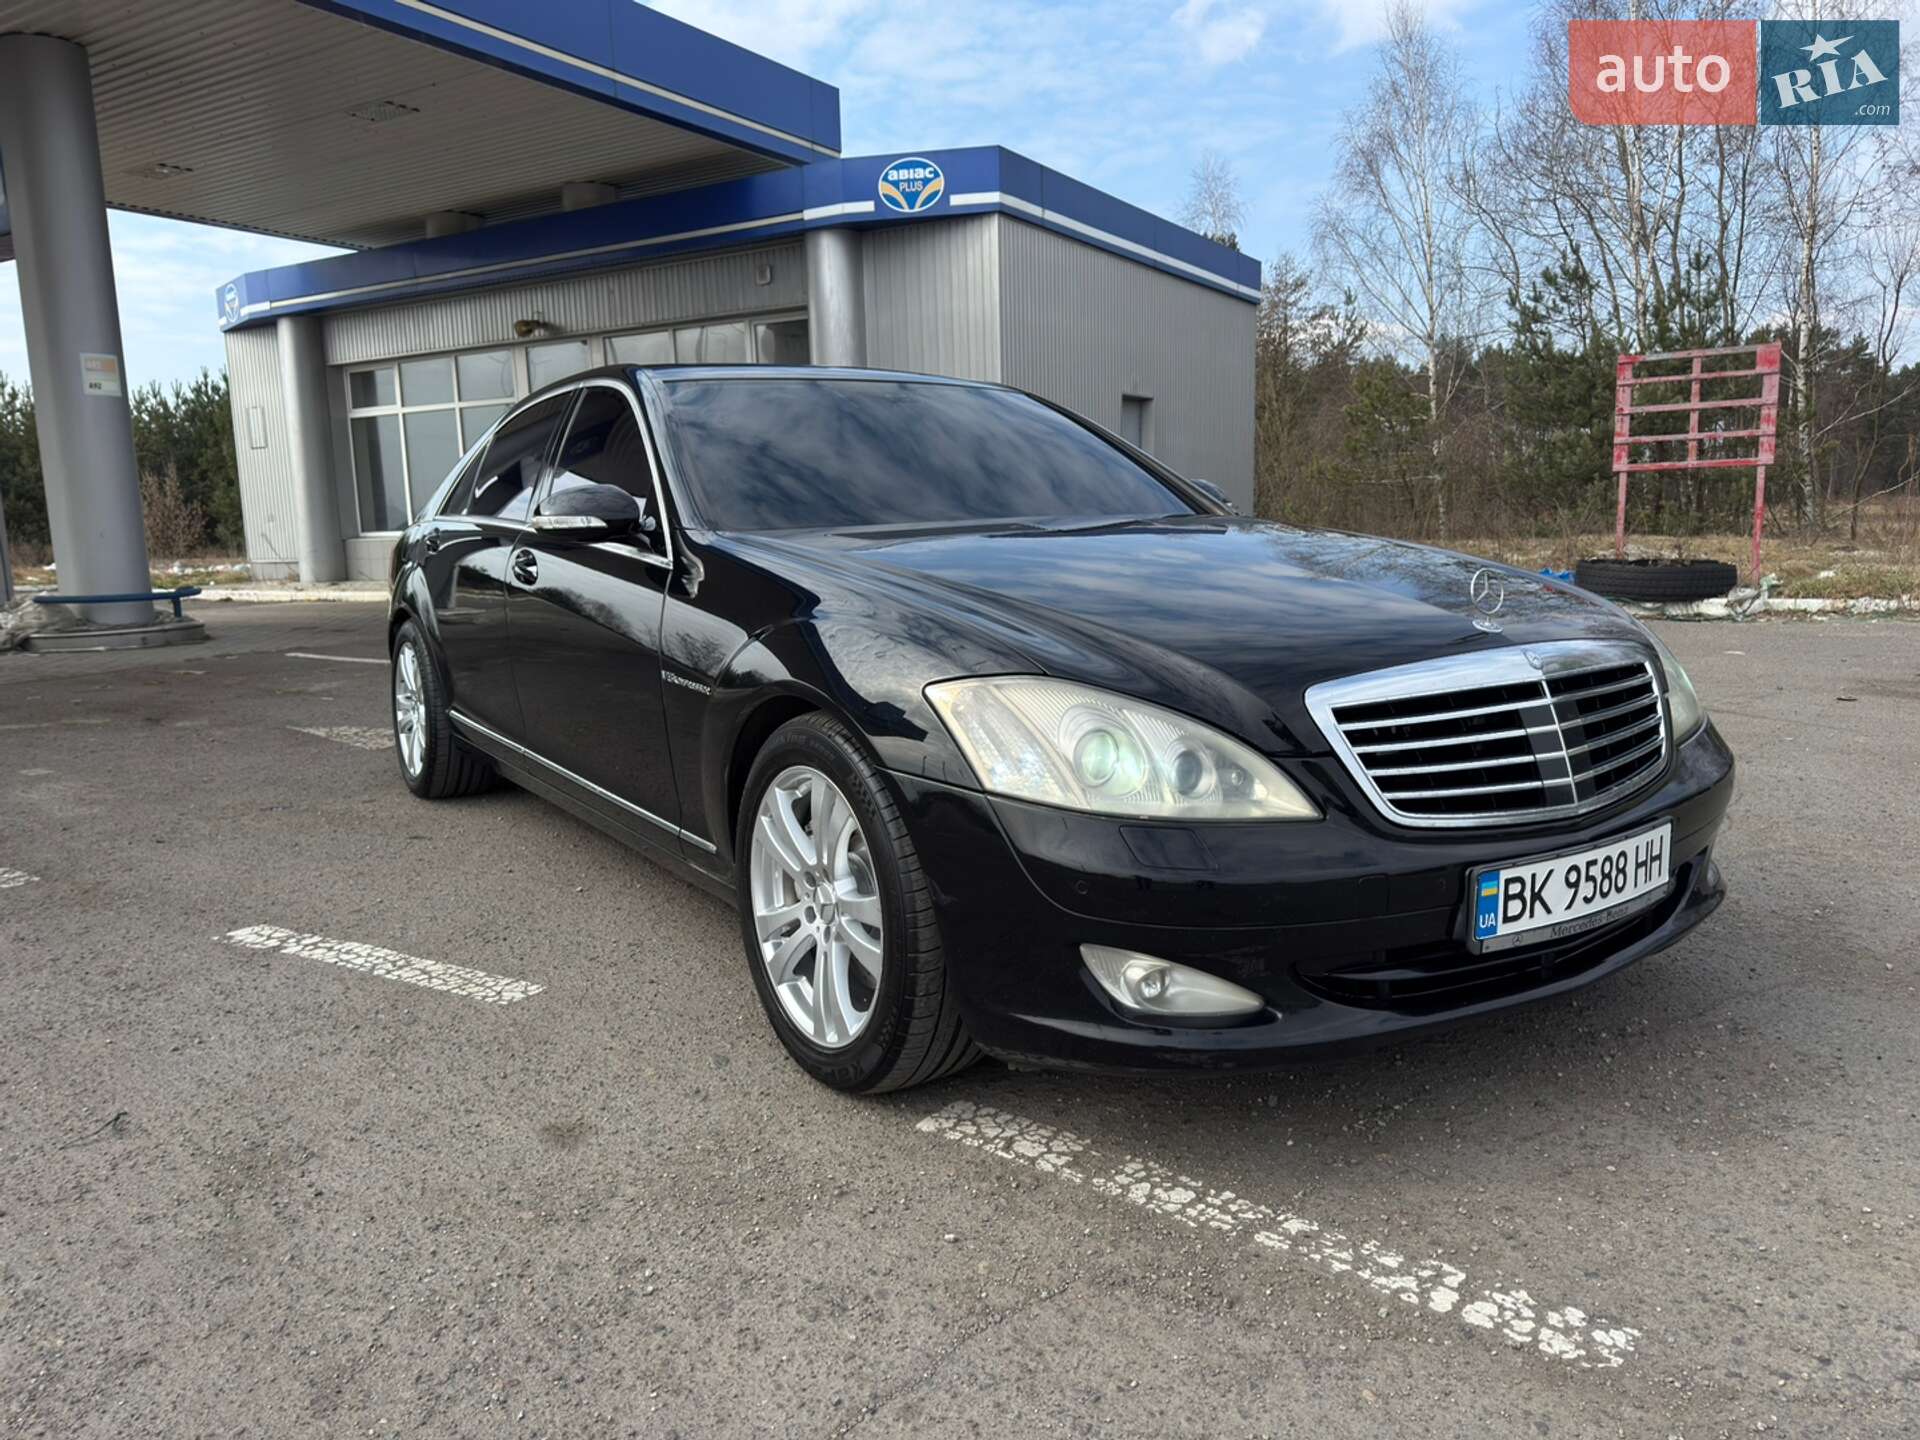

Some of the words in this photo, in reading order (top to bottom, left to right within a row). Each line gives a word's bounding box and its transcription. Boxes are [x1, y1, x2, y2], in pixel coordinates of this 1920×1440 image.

[899, 180, 924, 192] PLUS
[1502, 868, 1554, 925] BK
[1563, 850, 1628, 912] 9588
[1633, 834, 1665, 889] HH
[1478, 912, 1497, 929] UA
